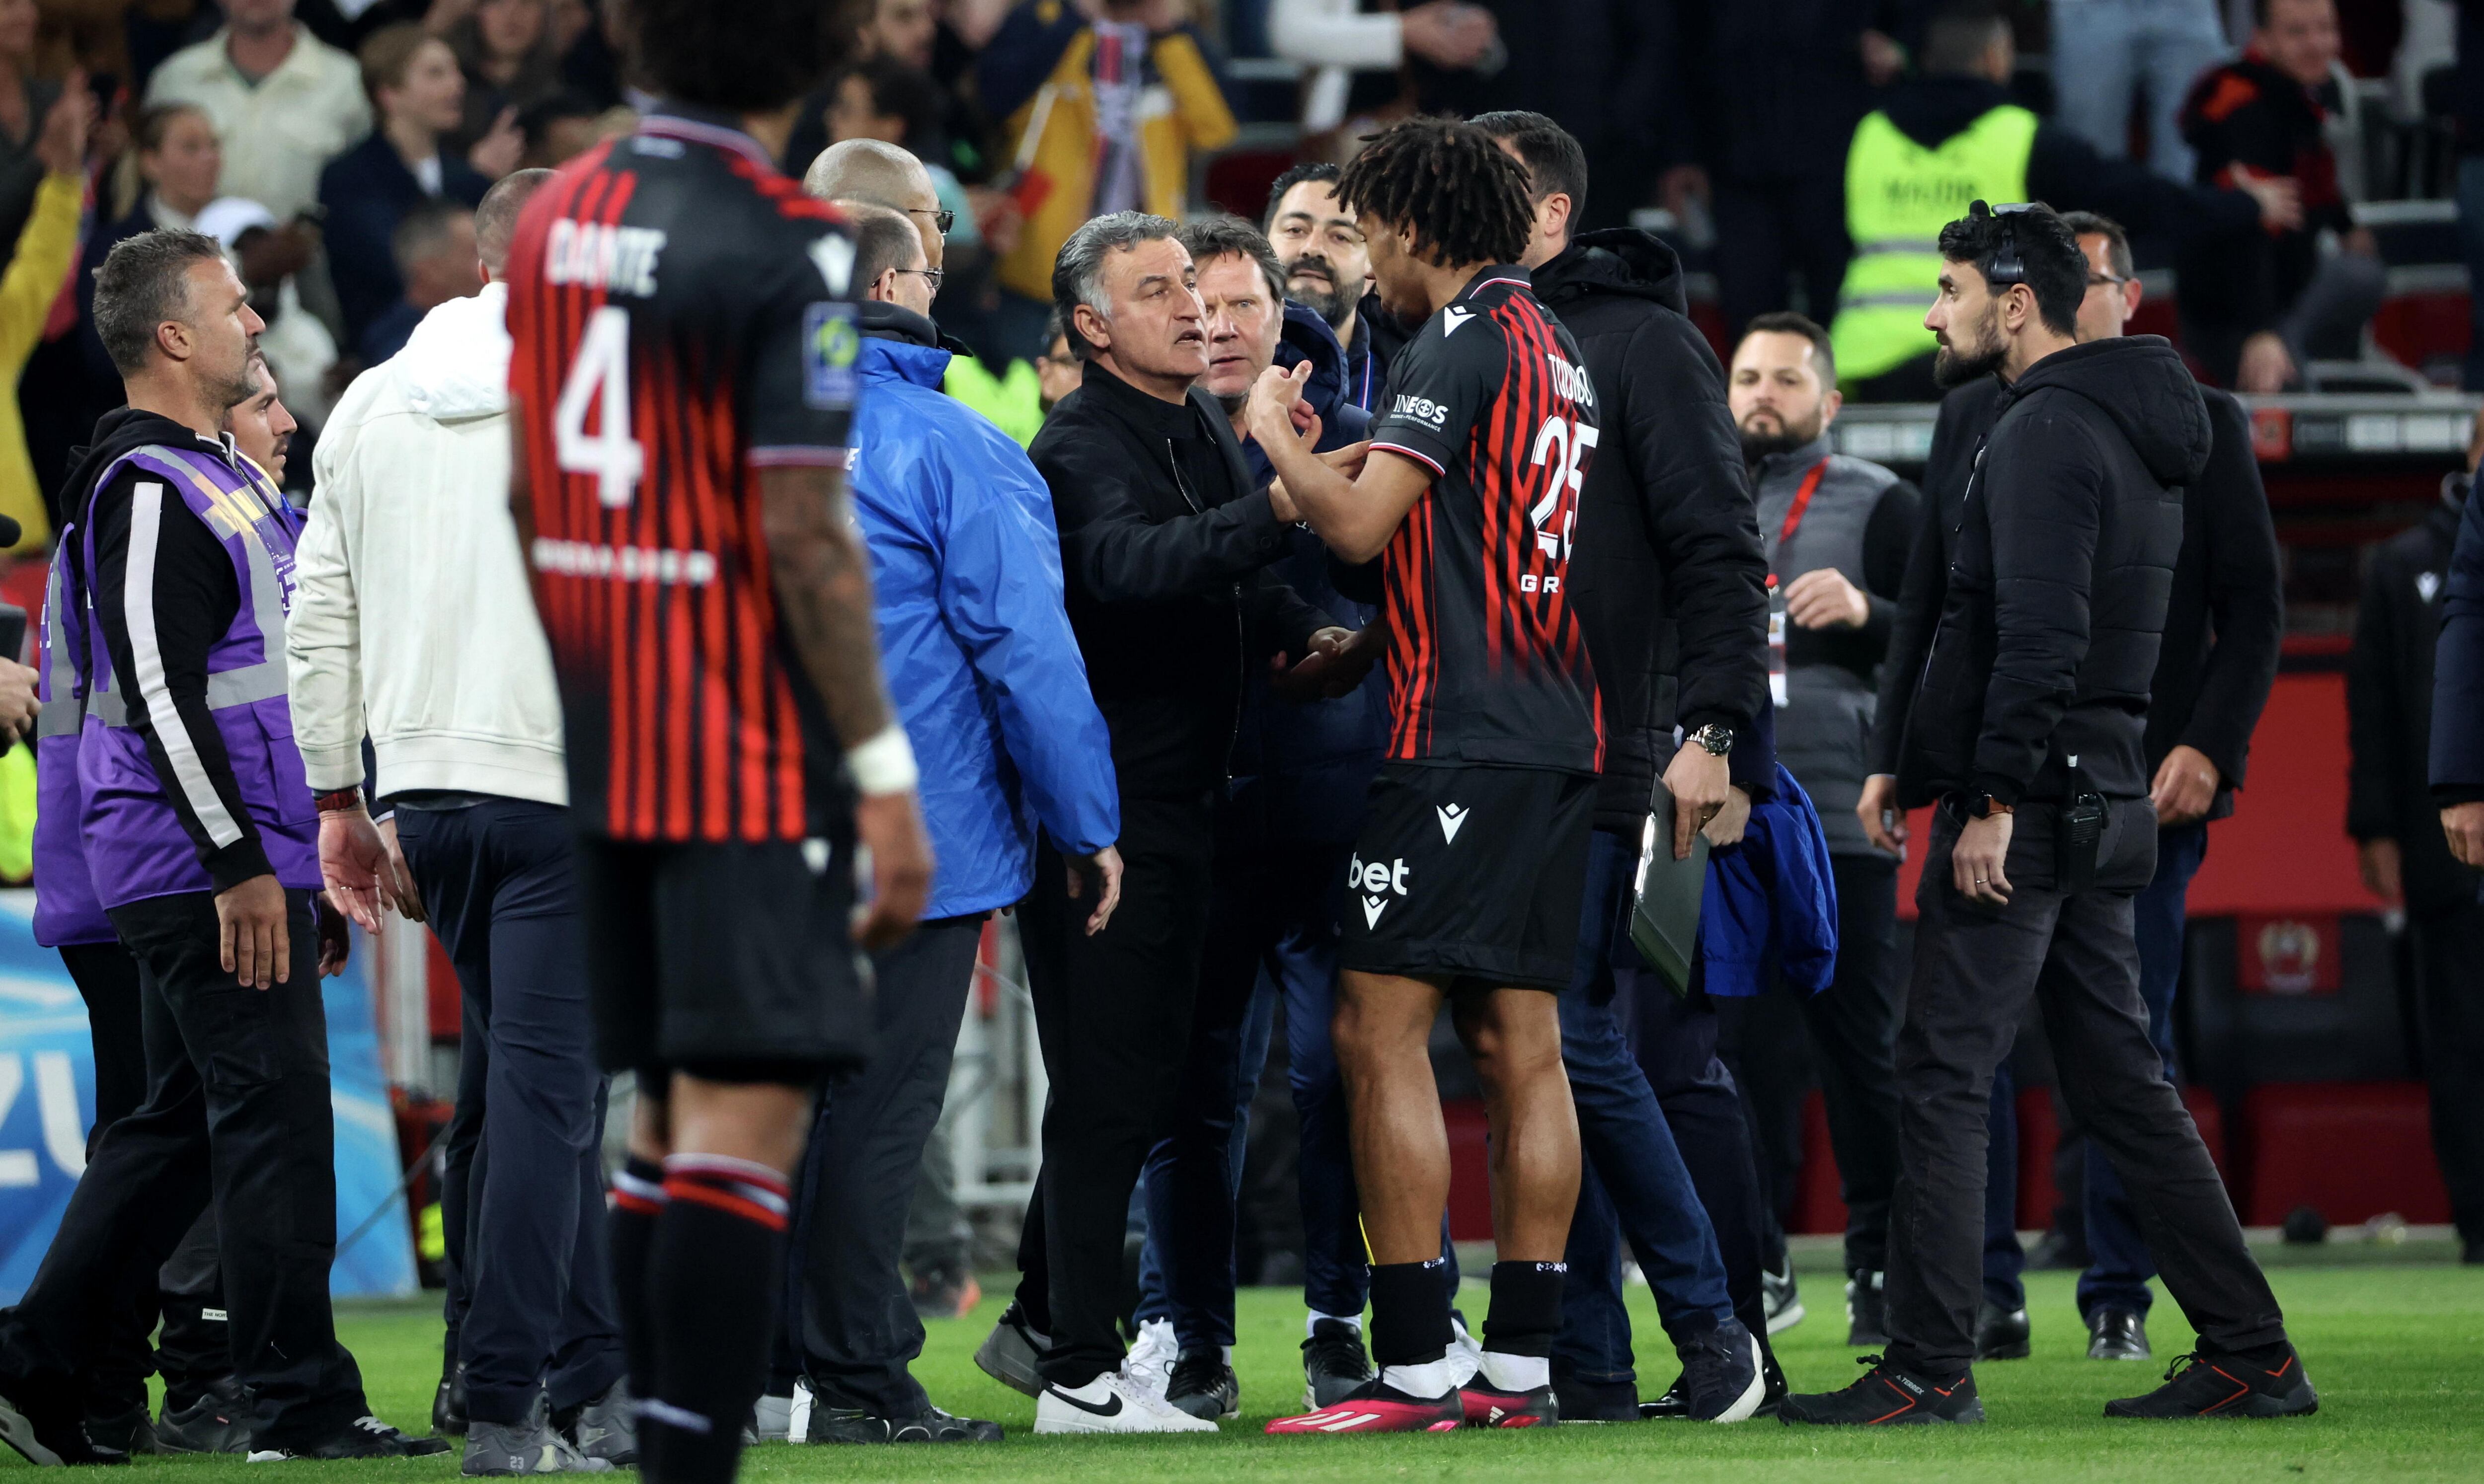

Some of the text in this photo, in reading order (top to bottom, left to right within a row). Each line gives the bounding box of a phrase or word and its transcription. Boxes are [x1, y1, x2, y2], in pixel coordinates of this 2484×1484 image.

[554, 305, 645, 508] 4
[1393, 394, 1449, 424] INEOS
[1530, 414, 1599, 564] 25
[1348, 851, 1409, 895] bet
[1901, 1377, 1924, 1395] TERREX
[510, 1456, 524, 1469] 23
